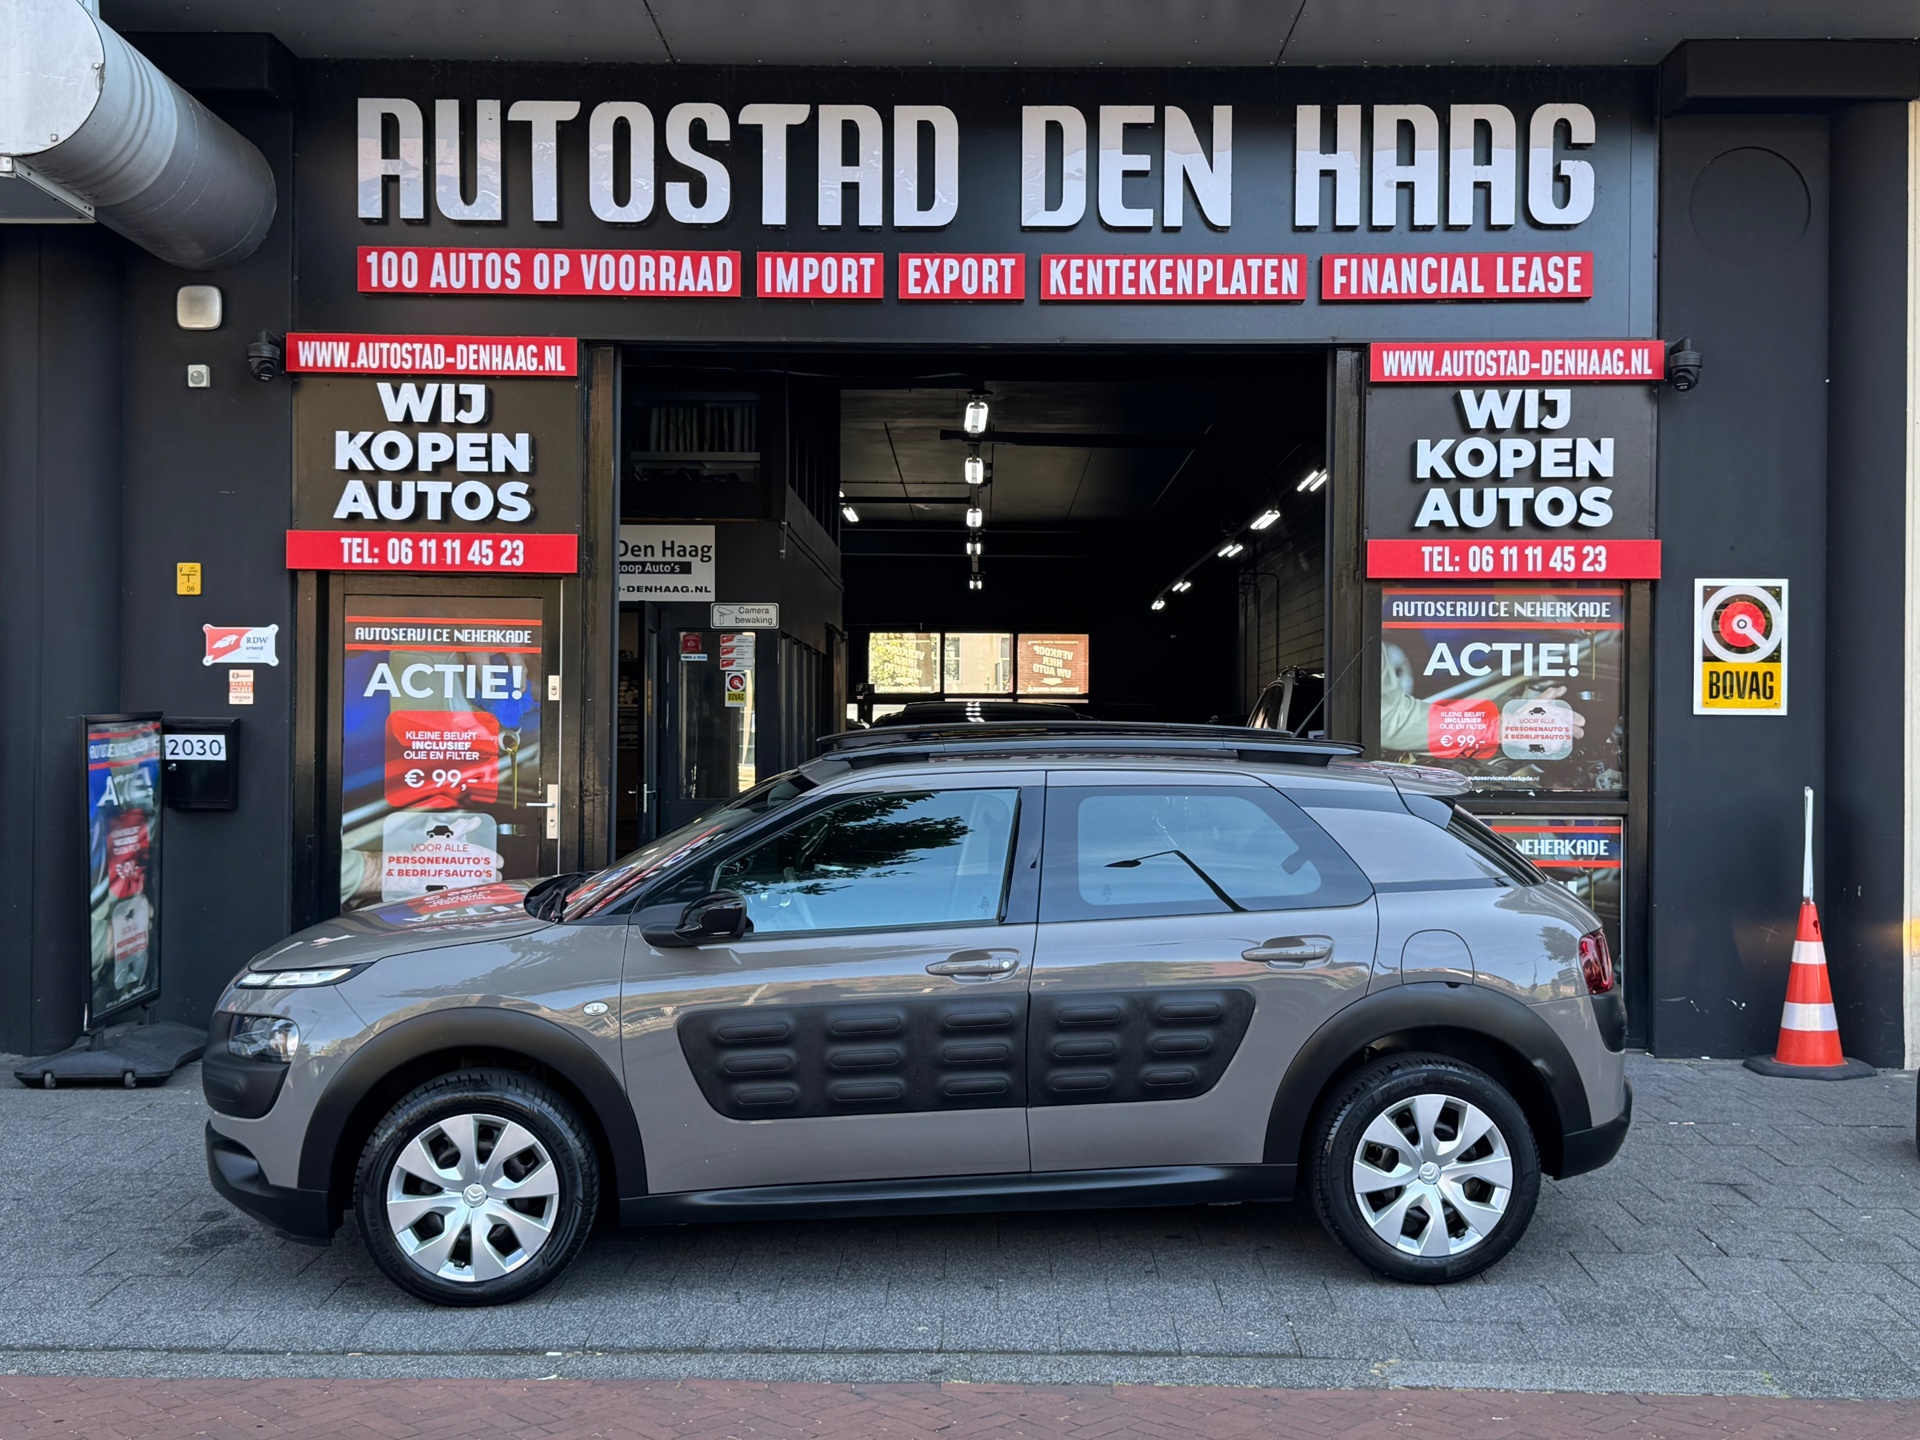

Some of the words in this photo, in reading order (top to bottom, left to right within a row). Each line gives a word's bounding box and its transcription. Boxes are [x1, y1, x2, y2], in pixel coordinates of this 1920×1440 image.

[357, 98, 959, 227] AUTOSTAD
[1021, 104, 1233, 227] DEN
[1295, 103, 1597, 227] HAAG
[366, 251, 419, 288] 100
[430, 252, 521, 289] AUTOS
[534, 253, 569, 290] OP
[581, 254, 734, 292] VOORRAAD
[764, 257, 875, 294] IMPORT
[907, 258, 1015, 295] EXPORT
[1049, 258, 1298, 295] KENTEKENPLATEN
[1333, 256, 1485, 294] FINANCIAL
[1496, 255, 1583, 293] LEASE
[298, 341, 566, 372] WWW.AUTOSTAD-DENHAAG.NL
[1382, 348, 1653, 377] WWW.AUTOSTAD-DENHAAG.NL
[376, 382, 486, 424] WIJ
[1460, 389, 1572, 430] WIJ
[334, 430, 530, 473] KOPEN
[1416, 437, 1615, 478] KOPEN
[333, 480, 532, 522] AUTOS
[1414, 486, 1614, 528] AUTOS
[340, 537, 379, 564] TEL:
[387, 538, 413, 564] 06
[419, 538, 436, 565] 11
[443, 539, 460, 565] 11
[467, 540, 494, 566] 45
[500, 540, 524, 566] 23
[619, 540, 655, 558] Den
[661, 540, 713, 563] Haag
[1421, 546, 1460, 572] TEL:
[1468, 546, 1494, 572] 06
[1500, 546, 1518, 572] 11
[1525, 545, 1542, 572] 11
[1549, 545, 1576, 572] 45
[1582, 545, 1607, 572] 23
[645, 562, 680, 573] Auto's
[618, 585, 712, 593] -DENHAAG.NL
[735, 616, 773, 625] bewaking
[738, 606, 770, 615] Camera
[1392, 601, 1509, 617] AUTOSERVICE
[1514, 601, 1611, 618] NEHERKADE
[355, 628, 450, 643] AUTOSERVICE
[454, 629, 532, 645] NEHERKADE
[1423, 643, 1579, 677] ACTIE!
[363, 662, 523, 700] ACTIE!
[1709, 670, 1774, 700] BOVAG
[728, 692, 745, 702] BOVAG
[168, 739, 222, 756] 2030
[405, 731, 441, 741] KLEINE
[443, 731, 477, 741] BEURT
[411, 741, 471, 751] INCLUSIEF
[1440, 735, 1454, 747] €
[1457, 735, 1486, 749] 99,-
[403, 751, 428, 760] OLIE
[429, 751, 444, 760] EN
[446, 751, 479, 761] FILTER
[404, 769, 425, 788] €
[431, 769, 478, 791] 99,-
[388, 856, 491, 865] PERSONENAUTO'S
[411, 843, 442, 853] VOOR
[444, 843, 469, 853] ALLE
[1514, 839, 1609, 855] NEHERKADE
[386, 869, 395, 877] &
[397, 868, 492, 878] BEDRIJFSAUTO'S
